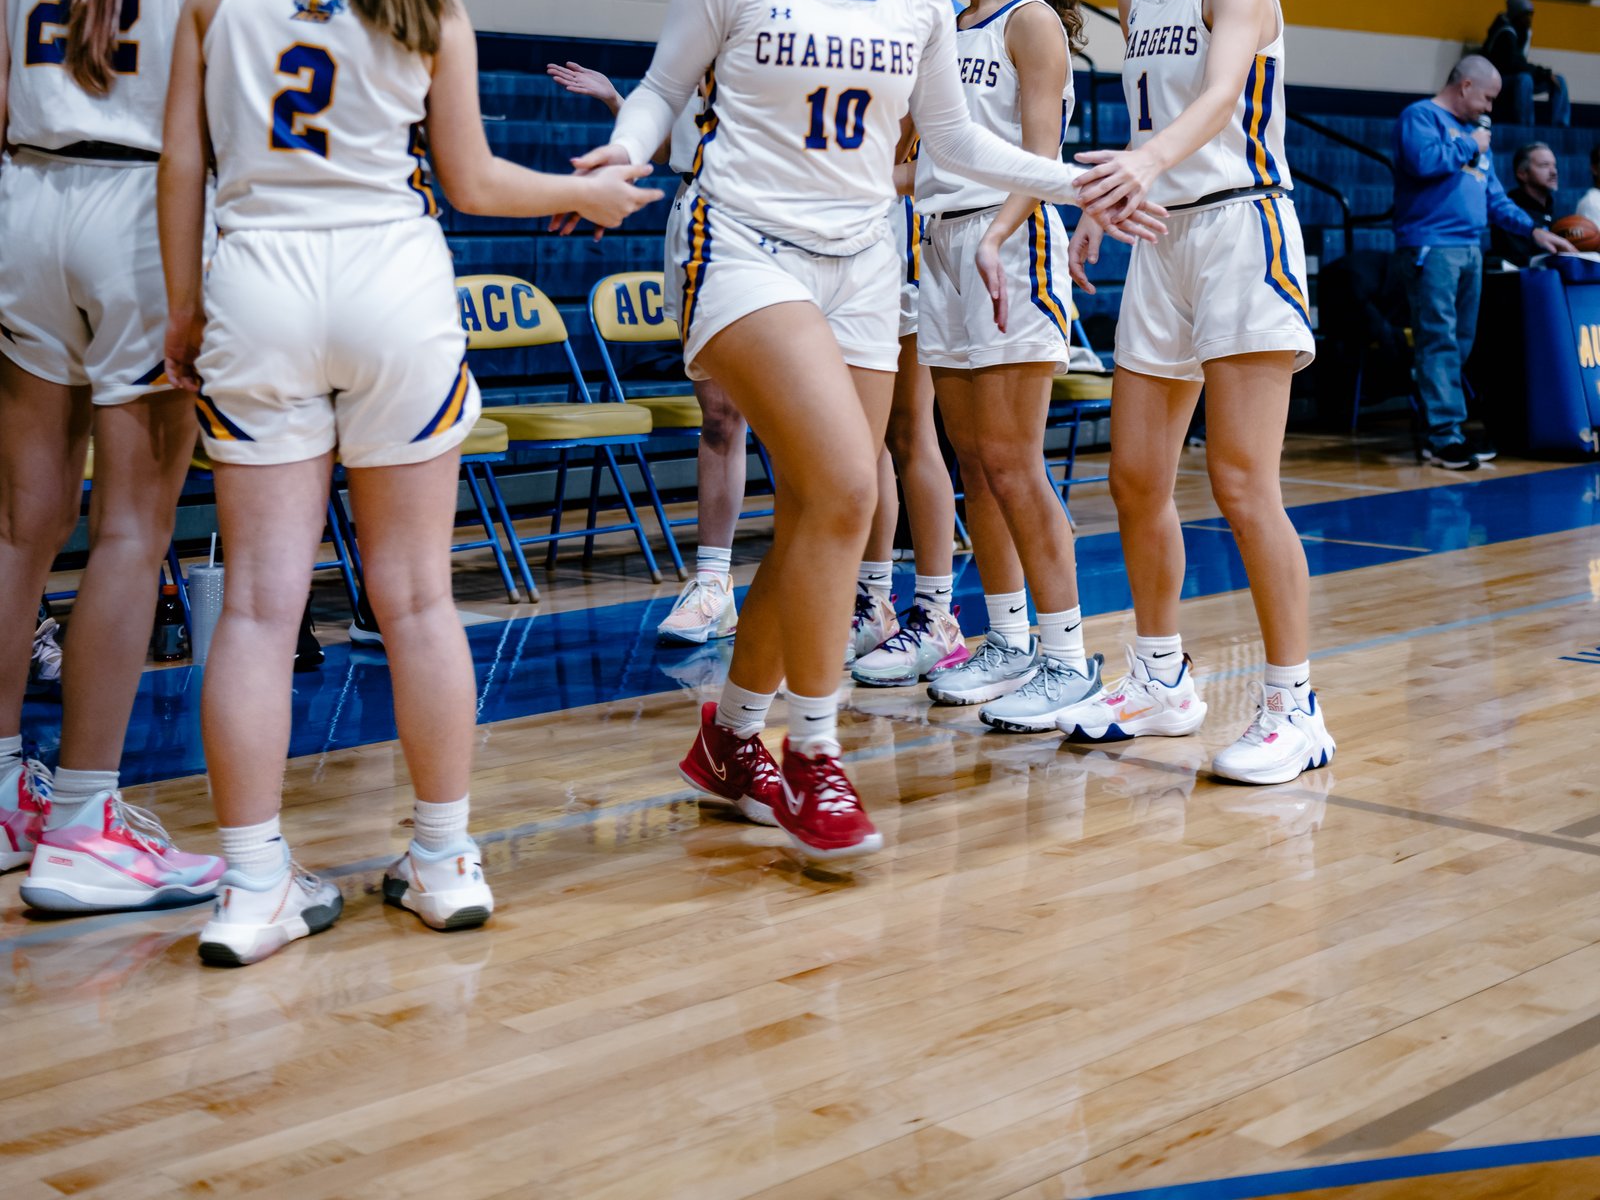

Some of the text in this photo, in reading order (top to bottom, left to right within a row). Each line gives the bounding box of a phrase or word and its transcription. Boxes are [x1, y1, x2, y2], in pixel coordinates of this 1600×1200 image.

[756, 31, 914, 76] CHARGERS
[957, 57, 1000, 88] ERS
[269, 43, 338, 159] 2
[803, 85, 873, 151] 10
[1137, 70, 1153, 132] 1
[457, 284, 541, 332] ACC
